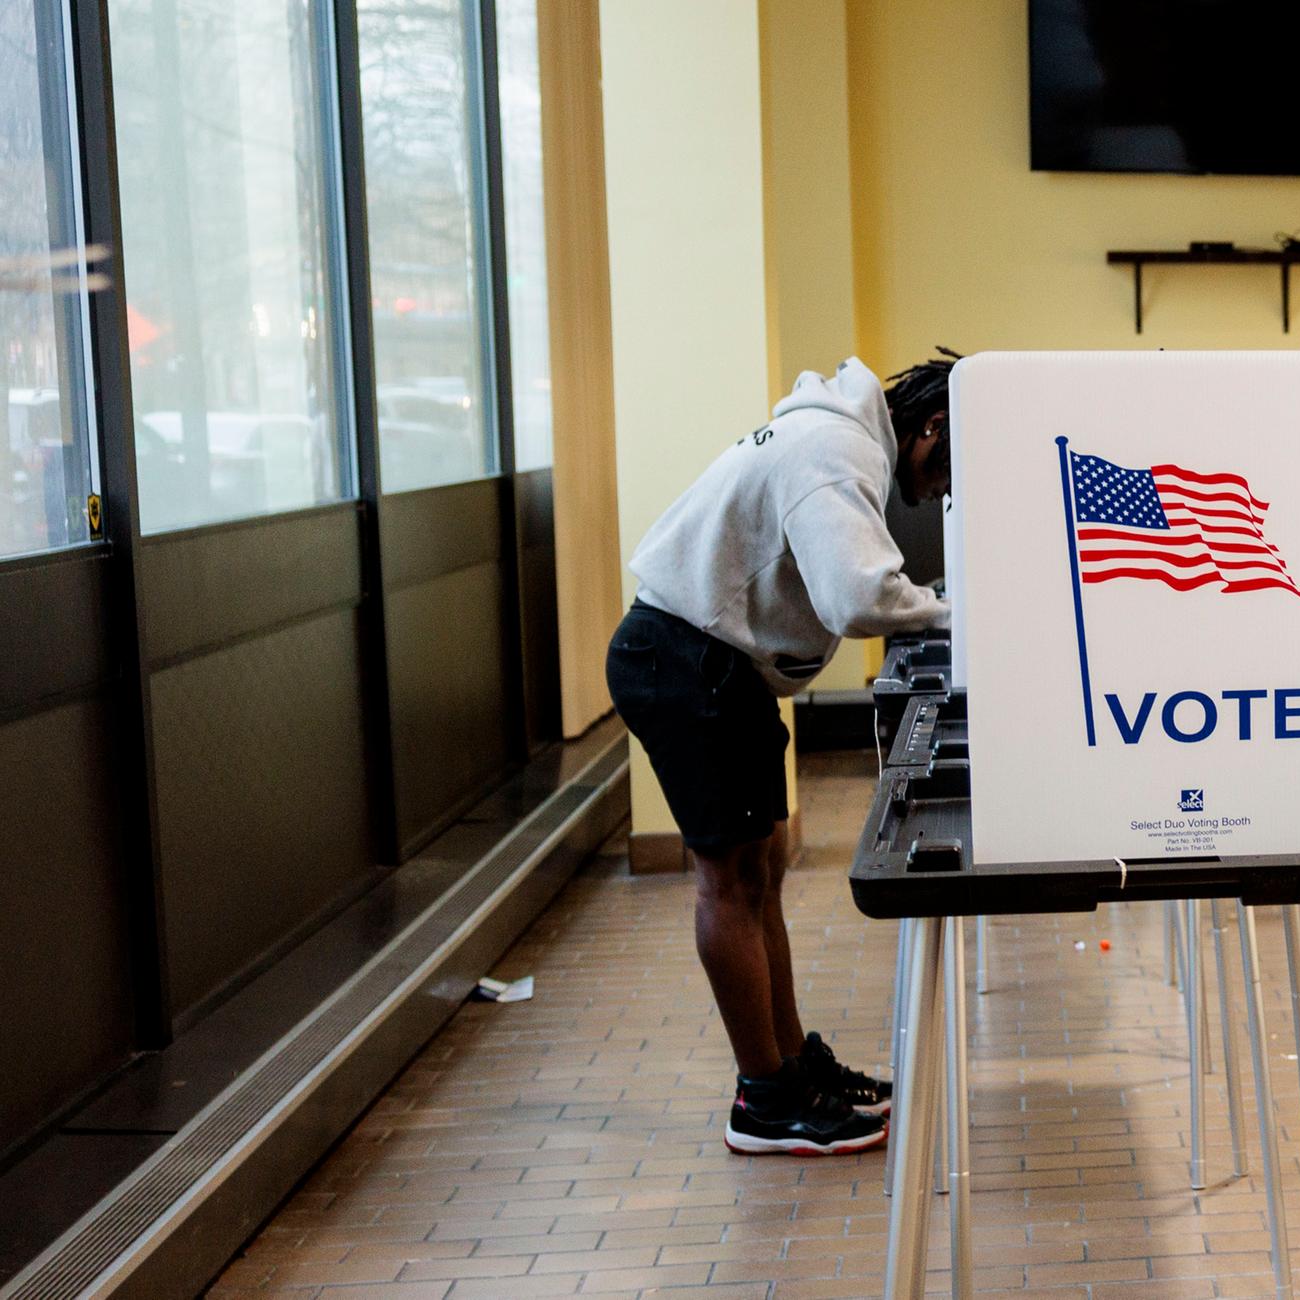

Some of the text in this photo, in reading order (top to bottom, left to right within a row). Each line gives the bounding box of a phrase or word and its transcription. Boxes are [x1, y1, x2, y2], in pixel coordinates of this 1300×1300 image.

[1177, 799, 1204, 809] select
[1130, 816, 1251, 830] Select Duo Voting Booth
